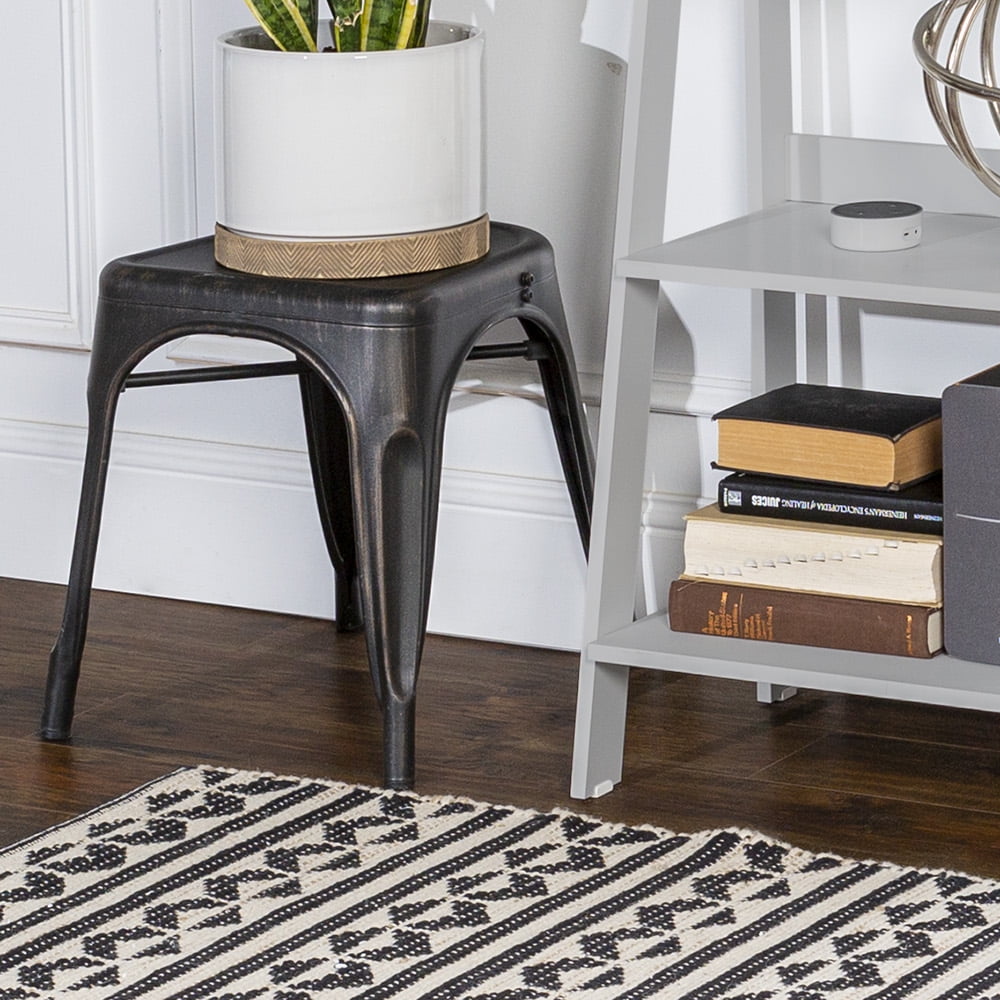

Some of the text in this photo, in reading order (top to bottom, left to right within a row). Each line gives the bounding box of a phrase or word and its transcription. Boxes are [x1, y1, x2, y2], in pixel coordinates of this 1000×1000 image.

[751, 495, 780, 509] JUICES
[782, 499, 810, 511] HEALING
[816, 502, 864, 516] ENCYCLOPEDIA
